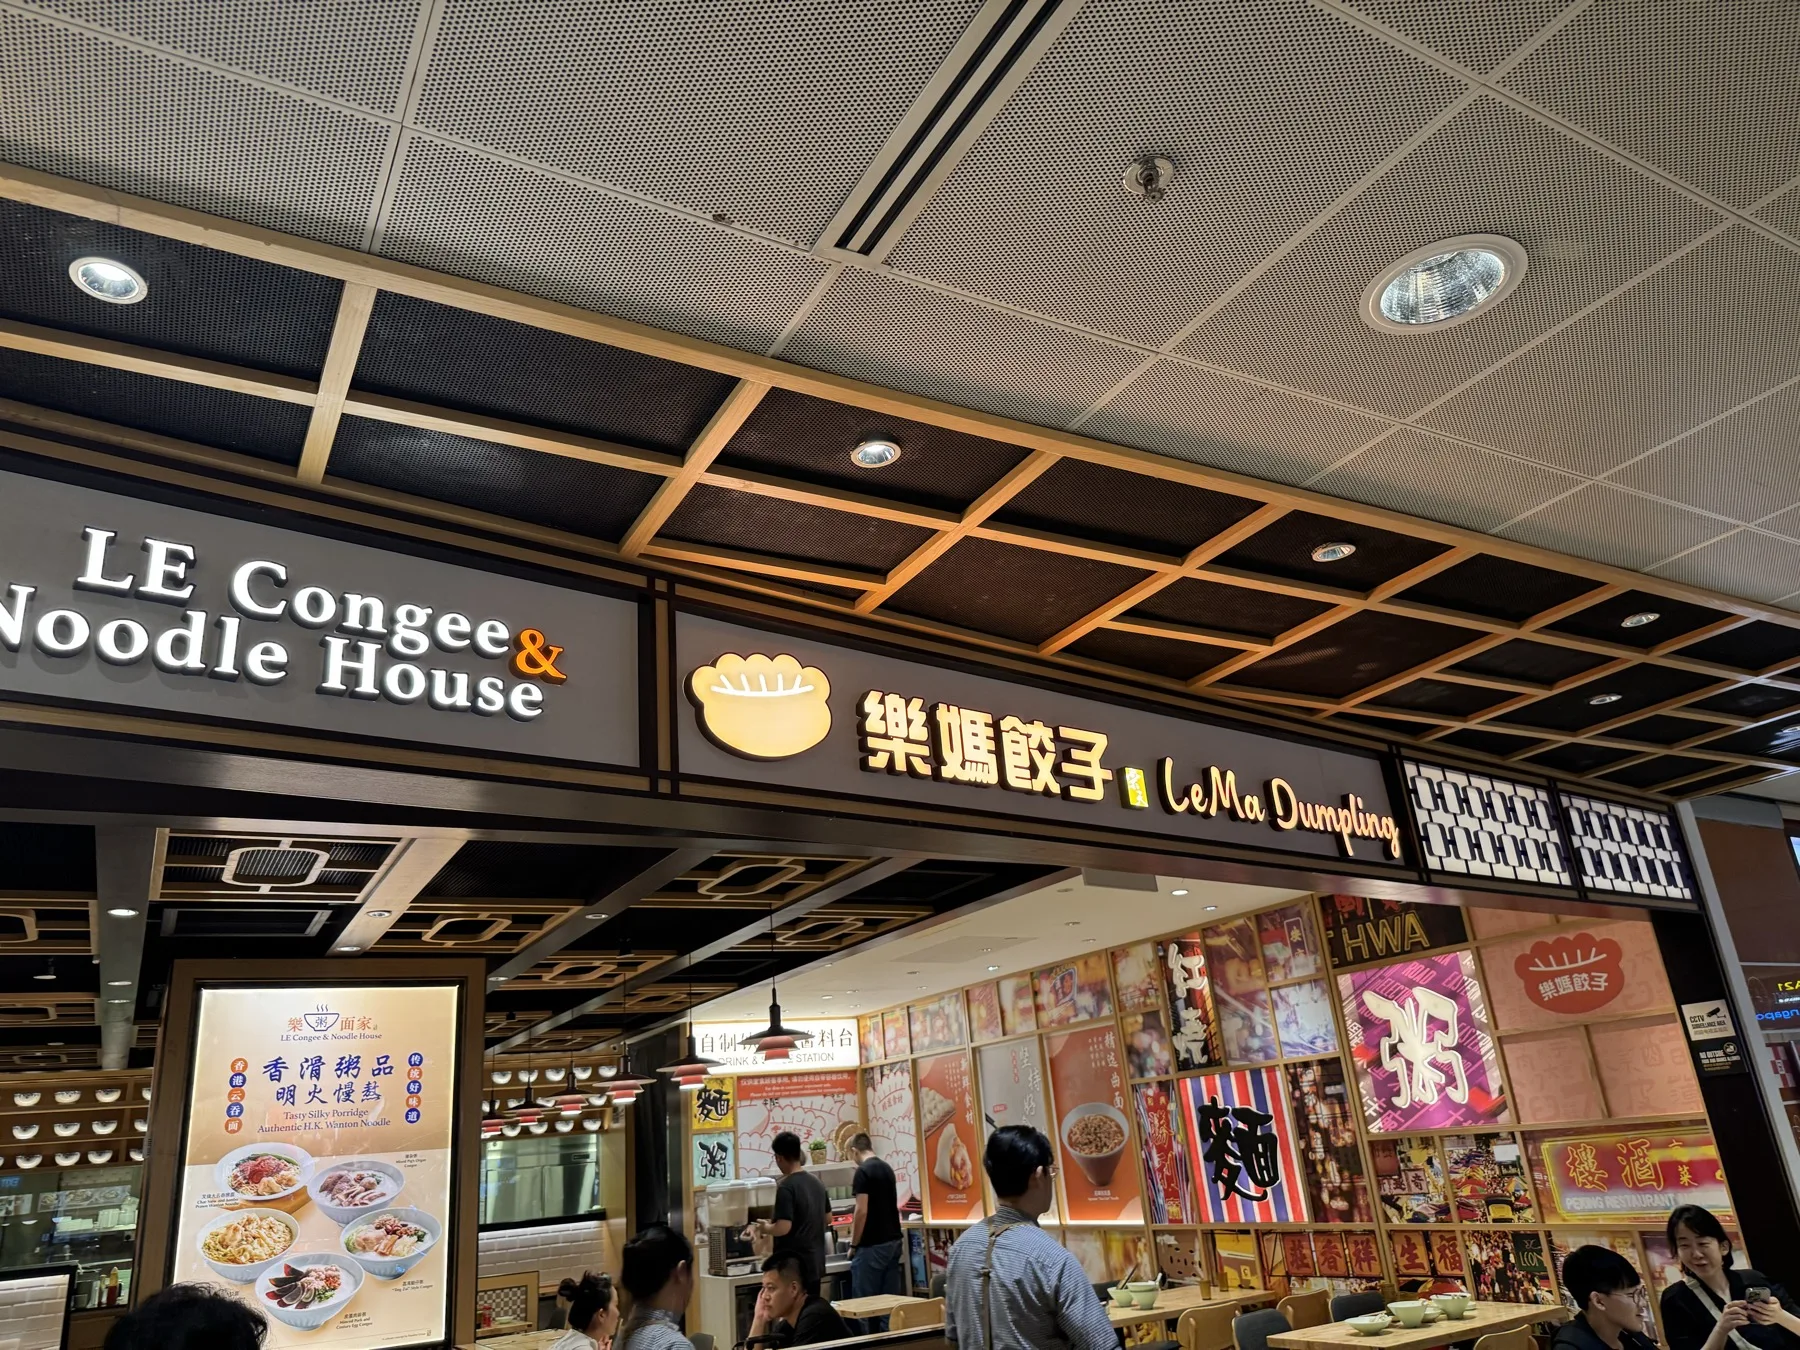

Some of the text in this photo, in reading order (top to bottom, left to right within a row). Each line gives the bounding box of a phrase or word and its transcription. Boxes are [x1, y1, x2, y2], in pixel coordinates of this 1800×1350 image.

[77, 525, 196, 603] LE
[228, 559, 511, 658] Congee
[315, 634, 545, 722] House
[862, 689, 1113, 802] 樂媽餃子
[1270, 776, 1401, 859] Dumpling
[1326, 909, 1431, 964] HWA
[1539, 972, 1609, 1001] 樂媽餃子
[1689, 1014, 1705, 1023] CCTV
[292, 1033, 321, 1043] Congee
[331, 1032, 358, 1041] Noodle
[359, 1031, 383, 1040] House
[262, 1053, 395, 1083] 香滑粥品
[751, 1056, 759, 1065] &
[796, 1052, 835, 1064] STATION
[257, 1117, 391, 1133] Authentic H.K. Wanton Noodle
[284, 1107, 369, 1122] Tasty Silky Porridge
